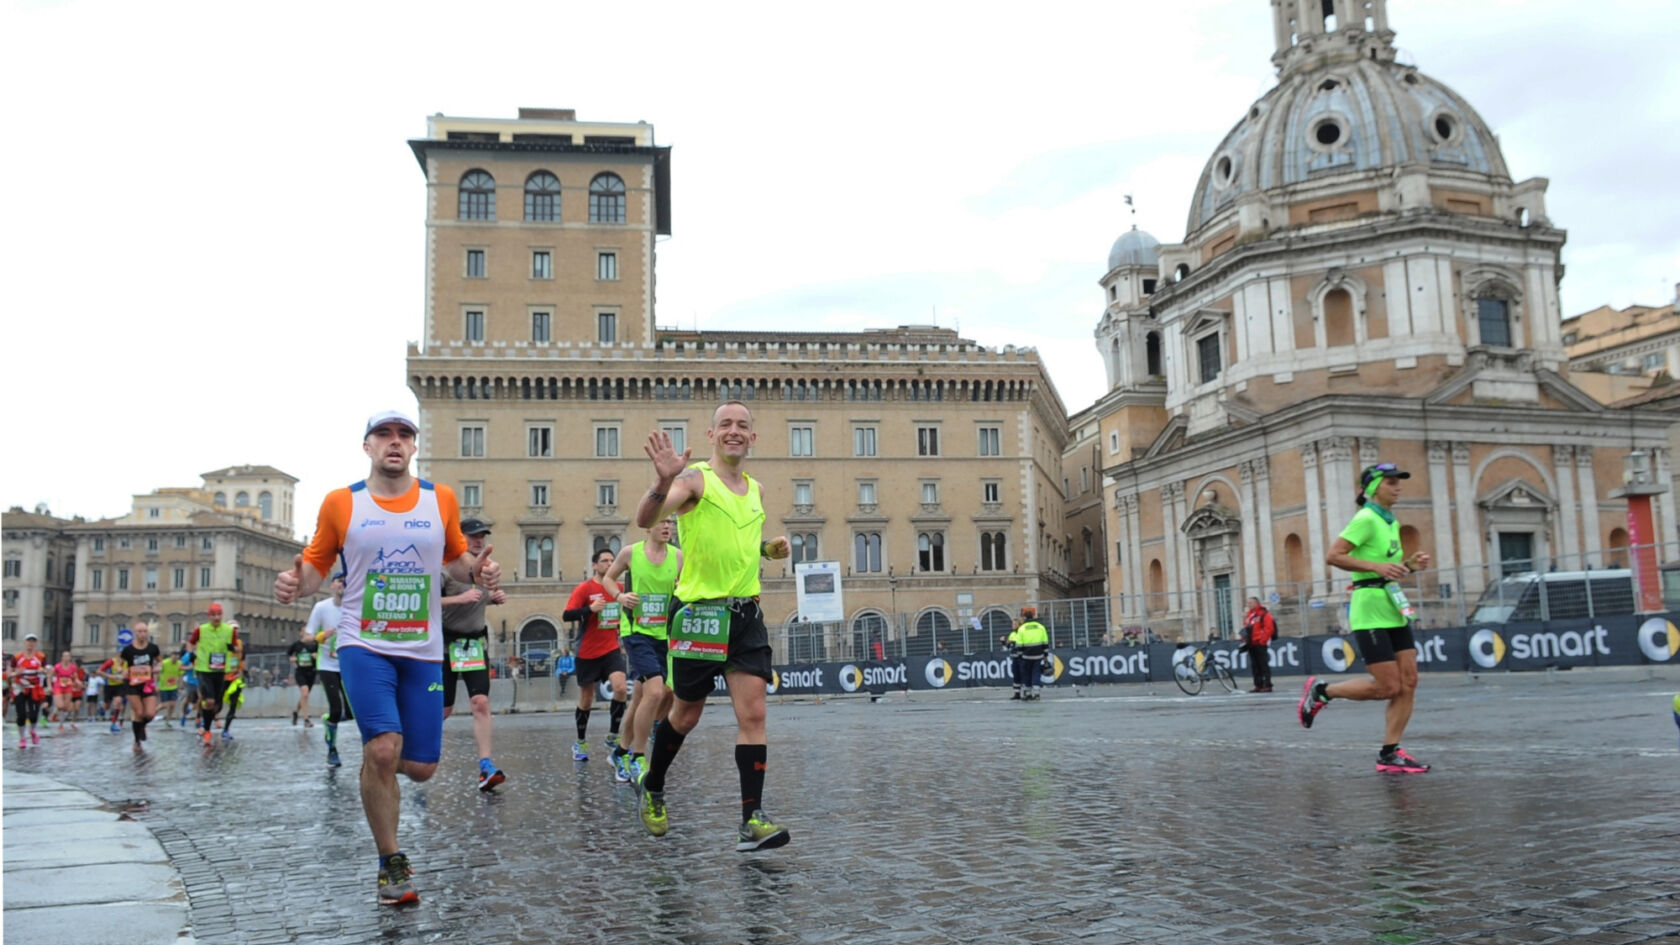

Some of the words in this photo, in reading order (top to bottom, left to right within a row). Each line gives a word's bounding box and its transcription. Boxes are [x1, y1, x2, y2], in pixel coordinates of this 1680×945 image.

[404, 518, 431, 528] nico
[373, 592, 421, 612] 6800
[642, 602, 665, 613] 6631
[682, 618, 720, 635] 5313
[1511, 625, 1610, 658] smart
[957, 657, 1014, 680] smart
[1069, 650, 1149, 676] smart
[782, 668, 823, 688] smart
[864, 663, 907, 685] smart
